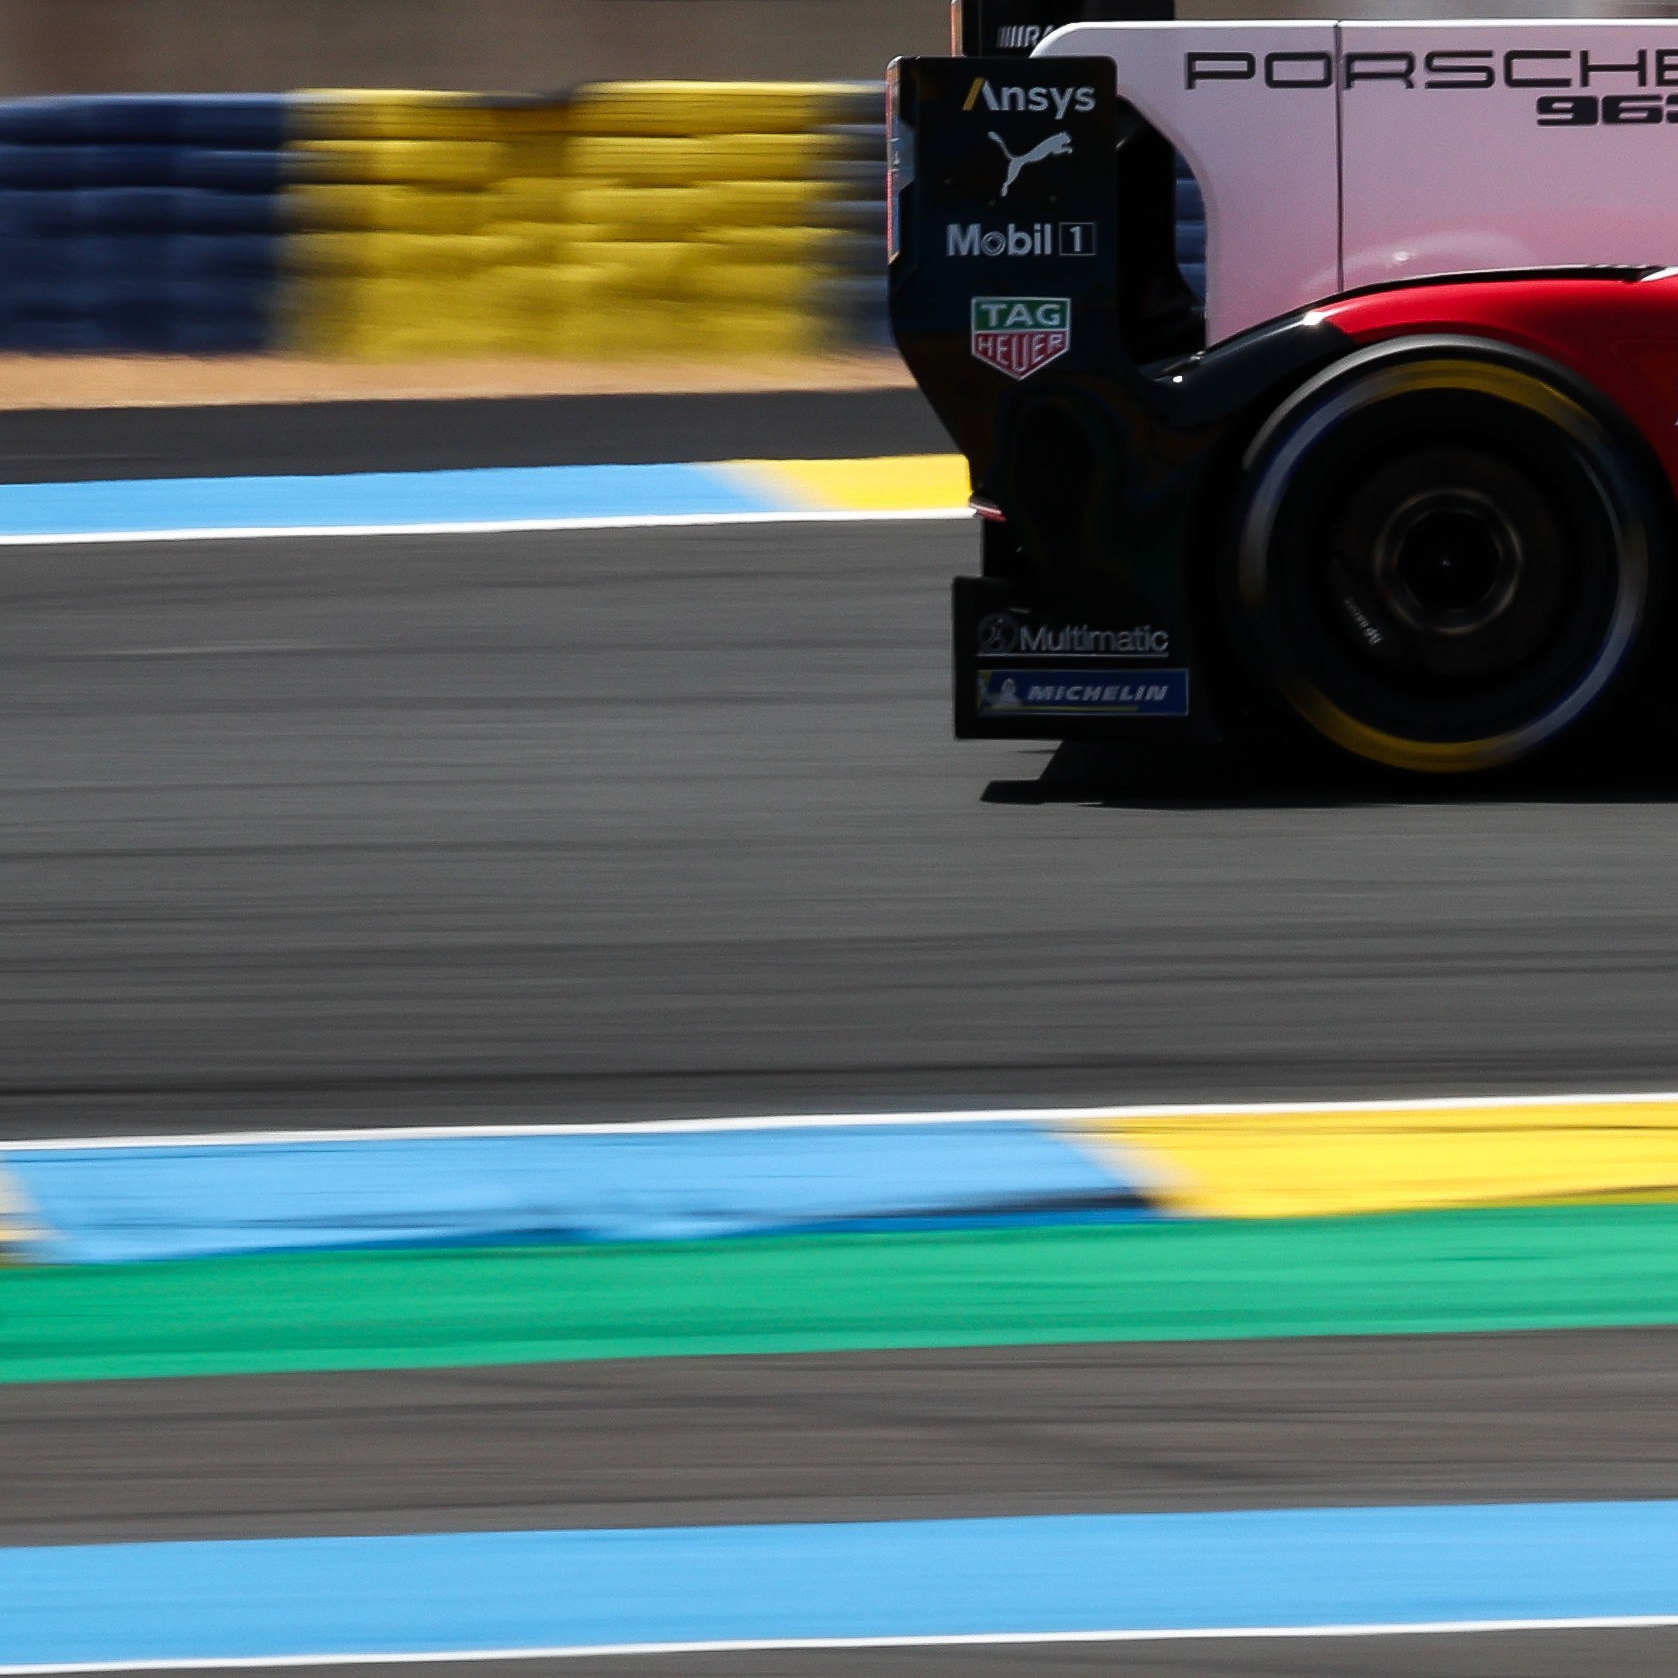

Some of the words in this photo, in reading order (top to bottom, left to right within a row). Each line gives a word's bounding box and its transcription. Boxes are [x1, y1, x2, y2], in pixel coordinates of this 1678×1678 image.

[962, 76, 1096, 120] Ansys
[946, 223, 1052, 257] Mobil
[980, 302, 1062, 328] TAG
[977, 332, 1064, 373] HEUER
[1019, 624, 1170, 652] Multimatic
[1026, 685, 1169, 702] MICHELIN
